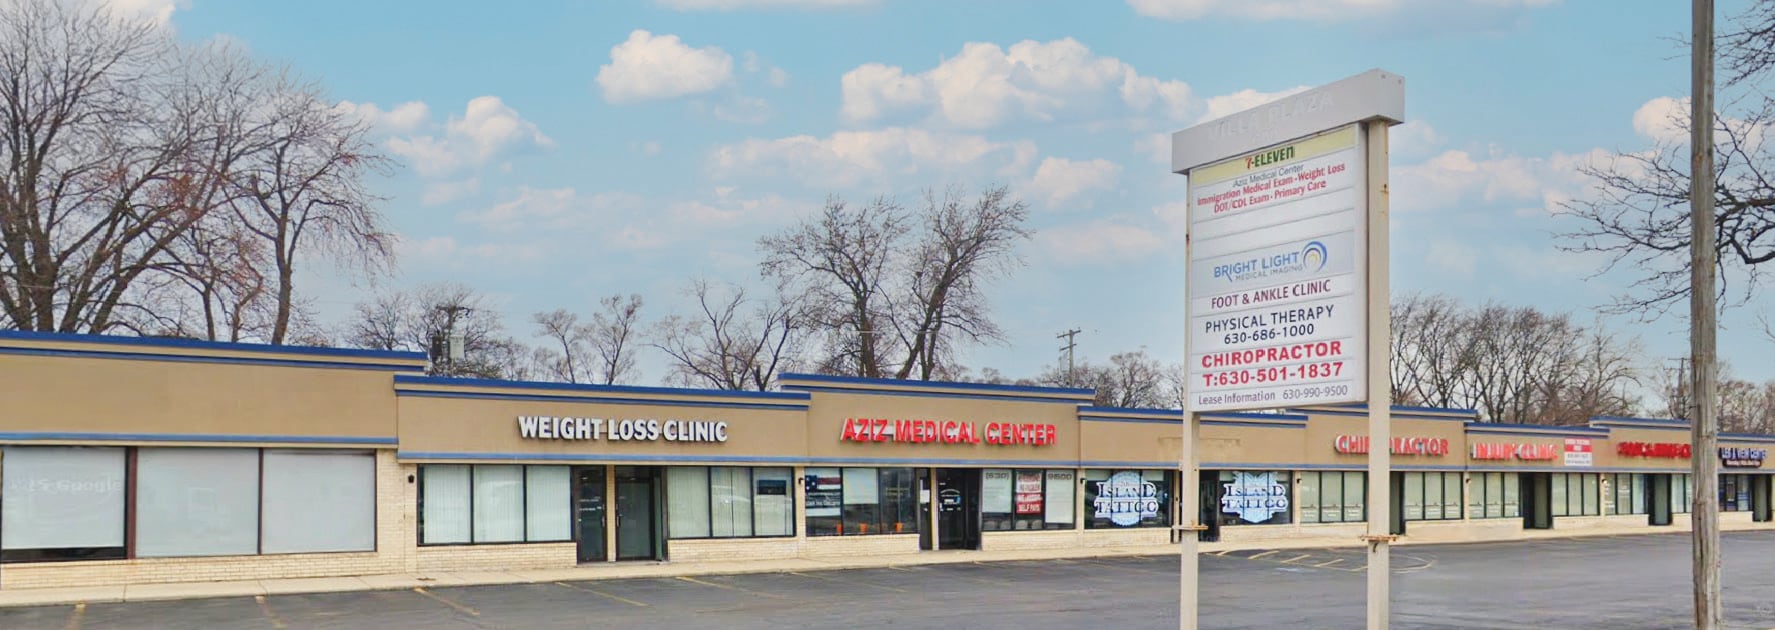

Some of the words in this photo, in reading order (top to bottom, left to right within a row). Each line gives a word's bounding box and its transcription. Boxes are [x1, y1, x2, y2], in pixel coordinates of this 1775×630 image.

[1197, 189, 1241, 206] Immigration
[1243, 182, 1271, 196] Medical
[1273, 177, 1294, 191] Exam
[1328, 163, 1346, 175] Loss
[1233, 178, 1248, 188] Aziz
[1250, 171, 1277, 184] Medical
[1279, 164, 1305, 177] Center
[1214, 199, 1248, 213] DOT/CDL
[1249, 195, 1270, 206] Exam
[1274, 186, 1305, 200] Primary
[1307, 180, 1327, 192] Care
[1214, 259, 1258, 282] BRIGHT
[1262, 252, 1300, 269] LIGHT
[1235, 271, 1268, 281] MEDICAL
[1270, 265, 1303, 276] IMAGING
[1211, 294, 1239, 309] FOOT
[1242, 293, 1250, 305] &
[1253, 286, 1289, 303] ANKLE
[1292, 279, 1332, 297] CLINIC
[1205, 315, 1267, 333] PHYSICAL
[1270, 304, 1334, 324] THERAPY
[1224, 323, 1315, 345] 630-686-1000
[1202, 341, 1342, 369] CHIROPRACTOR
[1202, 362, 1344, 387] T:630-501-1837
[1199, 394, 1223, 405] Lease
[1224, 390, 1276, 404] Information
[1283, 385, 1348, 400] 630-990-9500
[517, 416, 602, 440] WEIGHT
[607, 418, 659, 441] LOSS
[662, 420, 728, 442] CLINIC
[840, 418, 888, 443] AZIZ
[893, 419, 980, 445] MEDICAL
[985, 422, 1057, 446] CENTER
[1335, 435, 1449, 455] CHIRACTOR
[1098, 482, 1155, 498] ISLAND
[1226, 484, 1285, 497] ISLAND
